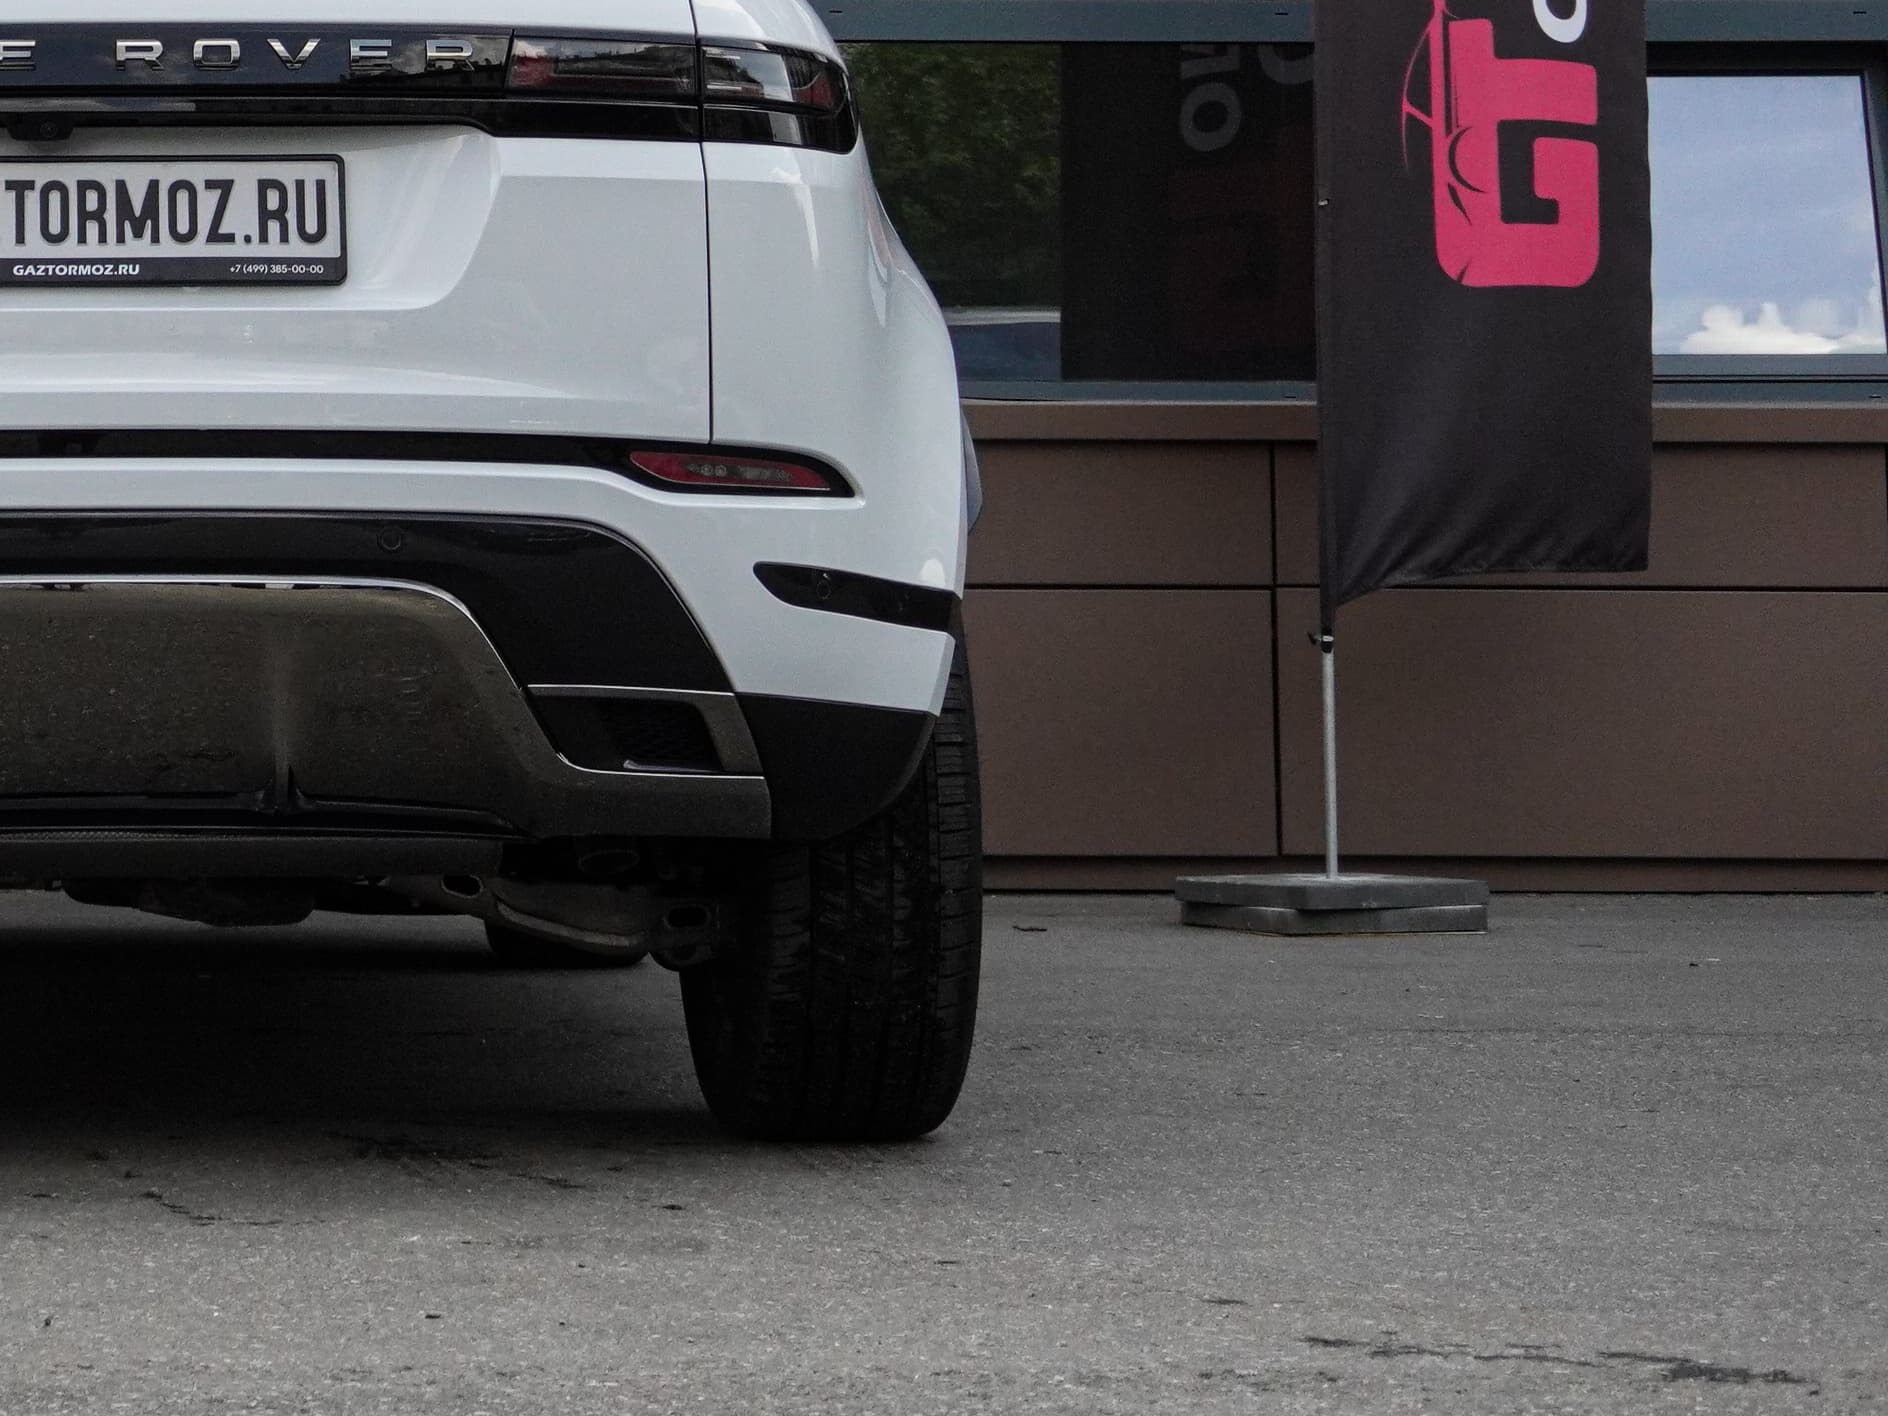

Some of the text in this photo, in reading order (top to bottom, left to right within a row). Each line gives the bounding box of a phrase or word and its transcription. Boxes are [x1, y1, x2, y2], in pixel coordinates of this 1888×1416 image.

[115, 37, 476, 72] ROVER
[12, 263, 140, 276] GAZTORMOZ.RU
[229, 263, 324, 275] +7 (499) 385-00-00
